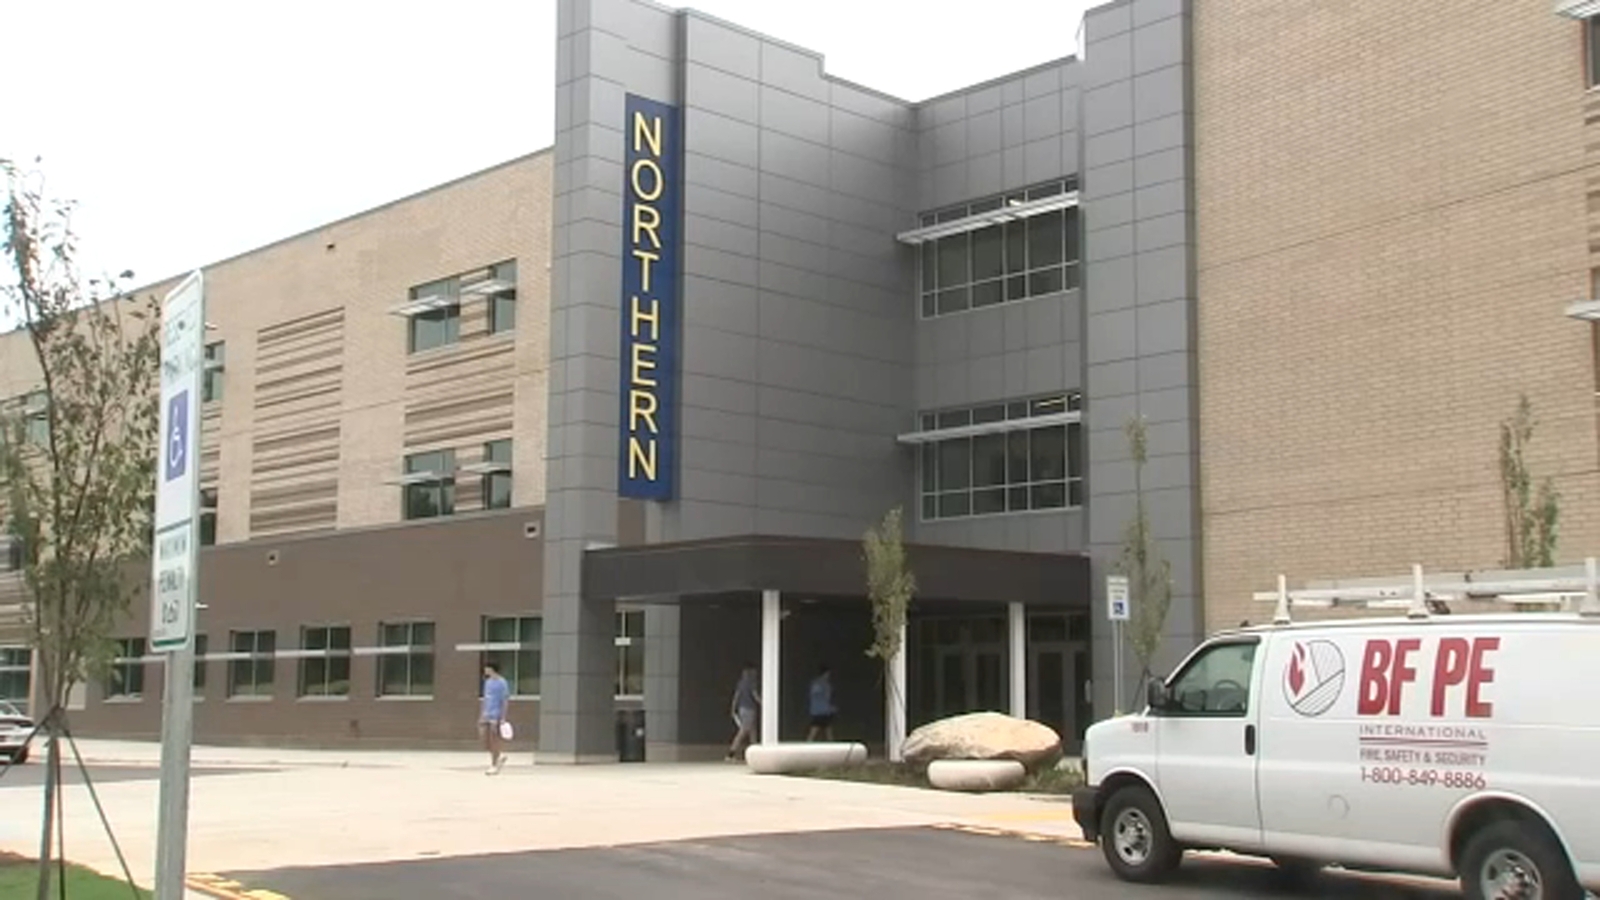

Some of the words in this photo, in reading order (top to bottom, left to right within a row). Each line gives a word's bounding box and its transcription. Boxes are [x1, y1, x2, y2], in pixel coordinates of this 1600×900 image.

[629, 111, 664, 482] NORTHERN
[1357, 638, 1421, 716] BF
[1430, 637, 1501, 718] PE
[1359, 724, 1487, 740] INTERNATIONAL
[1384, 749, 1420, 764] SAFETY
[1423, 751, 1432, 764] &
[1434, 751, 1486, 766] SECURITY
[1360, 766, 1487, 791] 1-800-849-8886
